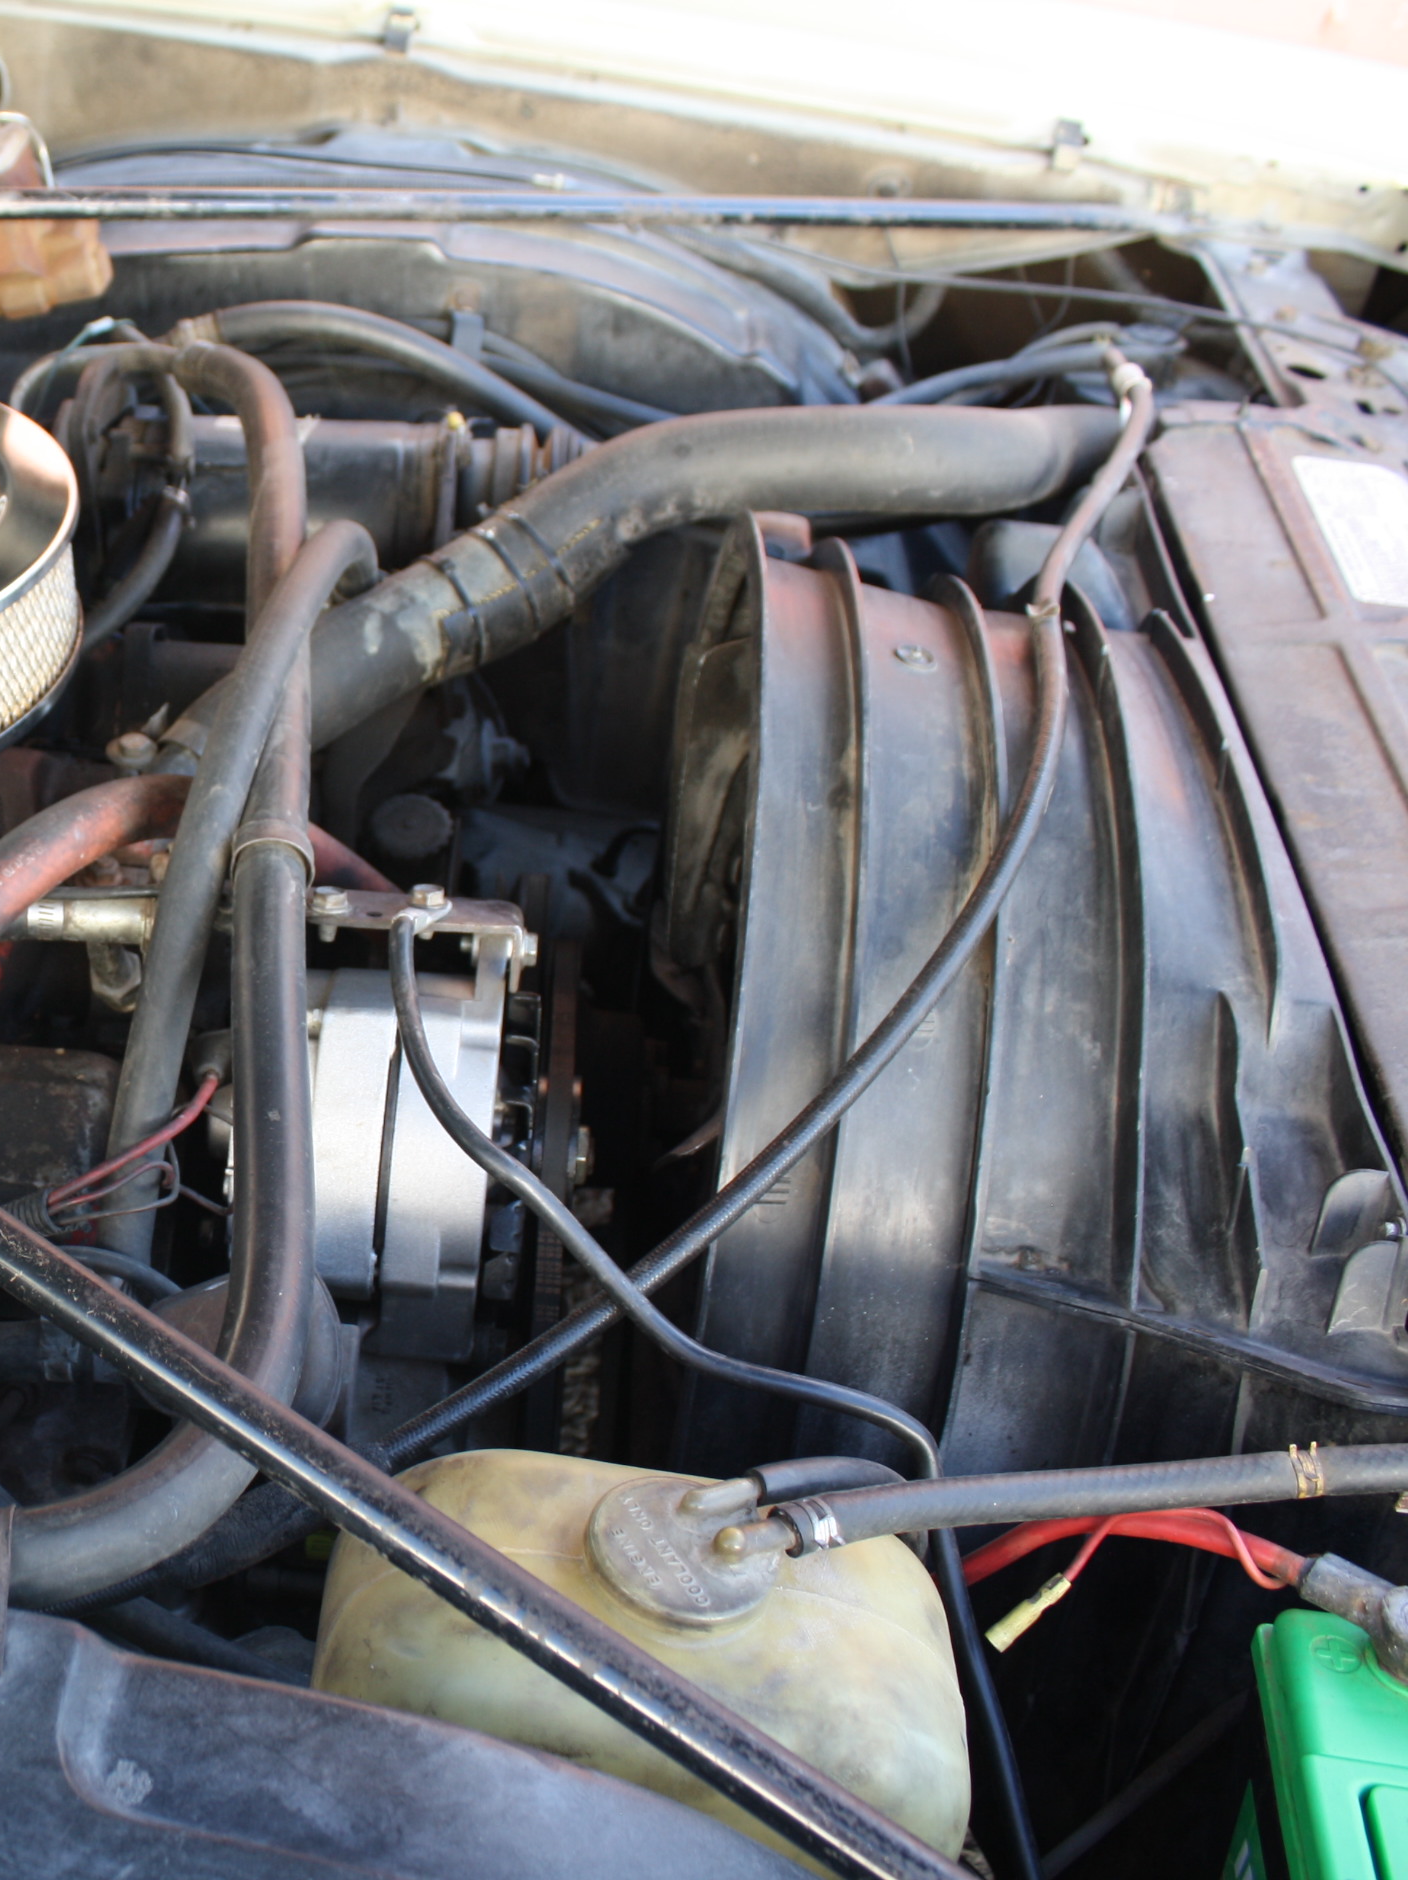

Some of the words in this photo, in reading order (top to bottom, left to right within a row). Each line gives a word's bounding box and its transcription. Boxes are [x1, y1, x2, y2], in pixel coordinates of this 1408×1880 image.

[622, 1496, 653, 1531] ONLY
[611, 1528, 662, 1587] ENGINE
[649, 1538, 710, 1607] COOLANT
